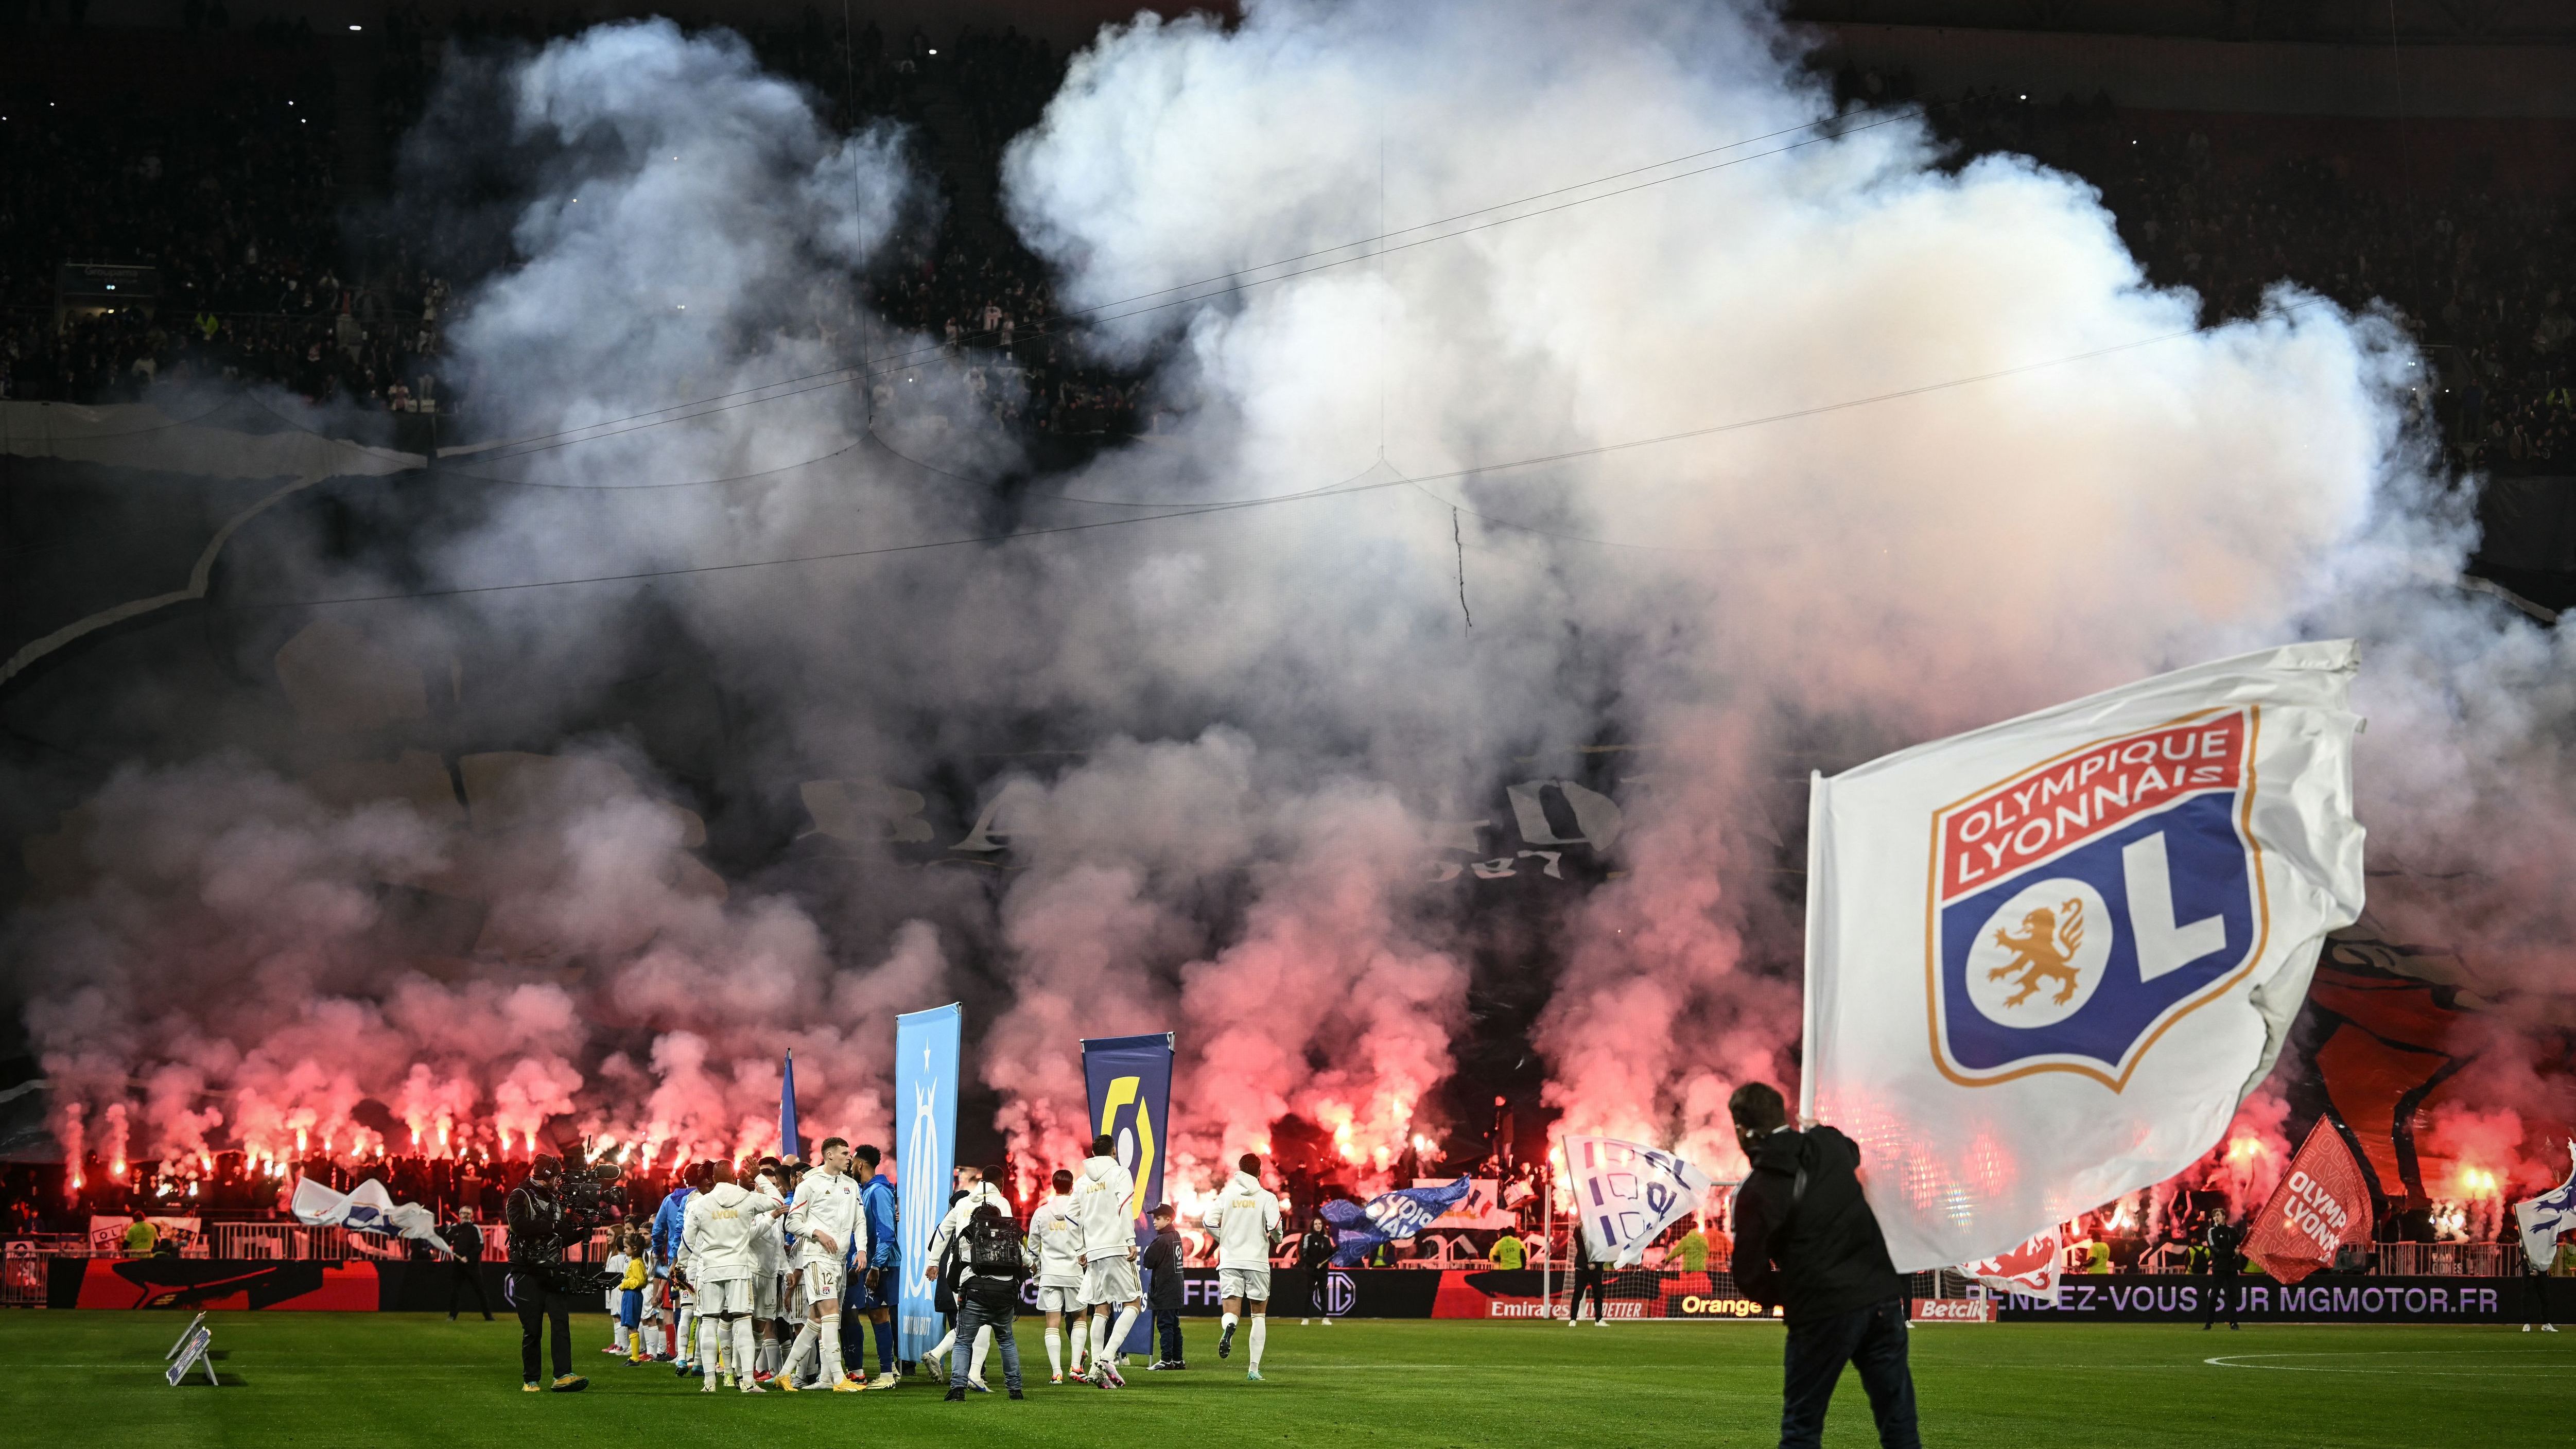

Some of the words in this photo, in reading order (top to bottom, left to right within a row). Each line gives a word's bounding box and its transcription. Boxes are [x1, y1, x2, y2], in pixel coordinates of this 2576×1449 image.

[1959, 729, 2229, 843] OLYMPIQUE
[1958, 765, 2224, 885] LYONNAIS
[1966, 830, 2227, 1029] OL
[1087, 1181, 1106, 1194] LYON
[1232, 1200, 1256, 1209] LYON
[712, 1210, 738, 1219] LYON
[1049, 1221, 1067, 1231] LYO
[822, 1272, 833, 1285] 12
[1491, 1301, 1570, 1317] Emiraes
[1682, 1296, 1762, 1317] Orange
[2280, 1287, 2498, 1313] MGMOTOR.FR
[913, 1316, 919, 1336] AU
[919, 1317, 931, 1336] BUT
